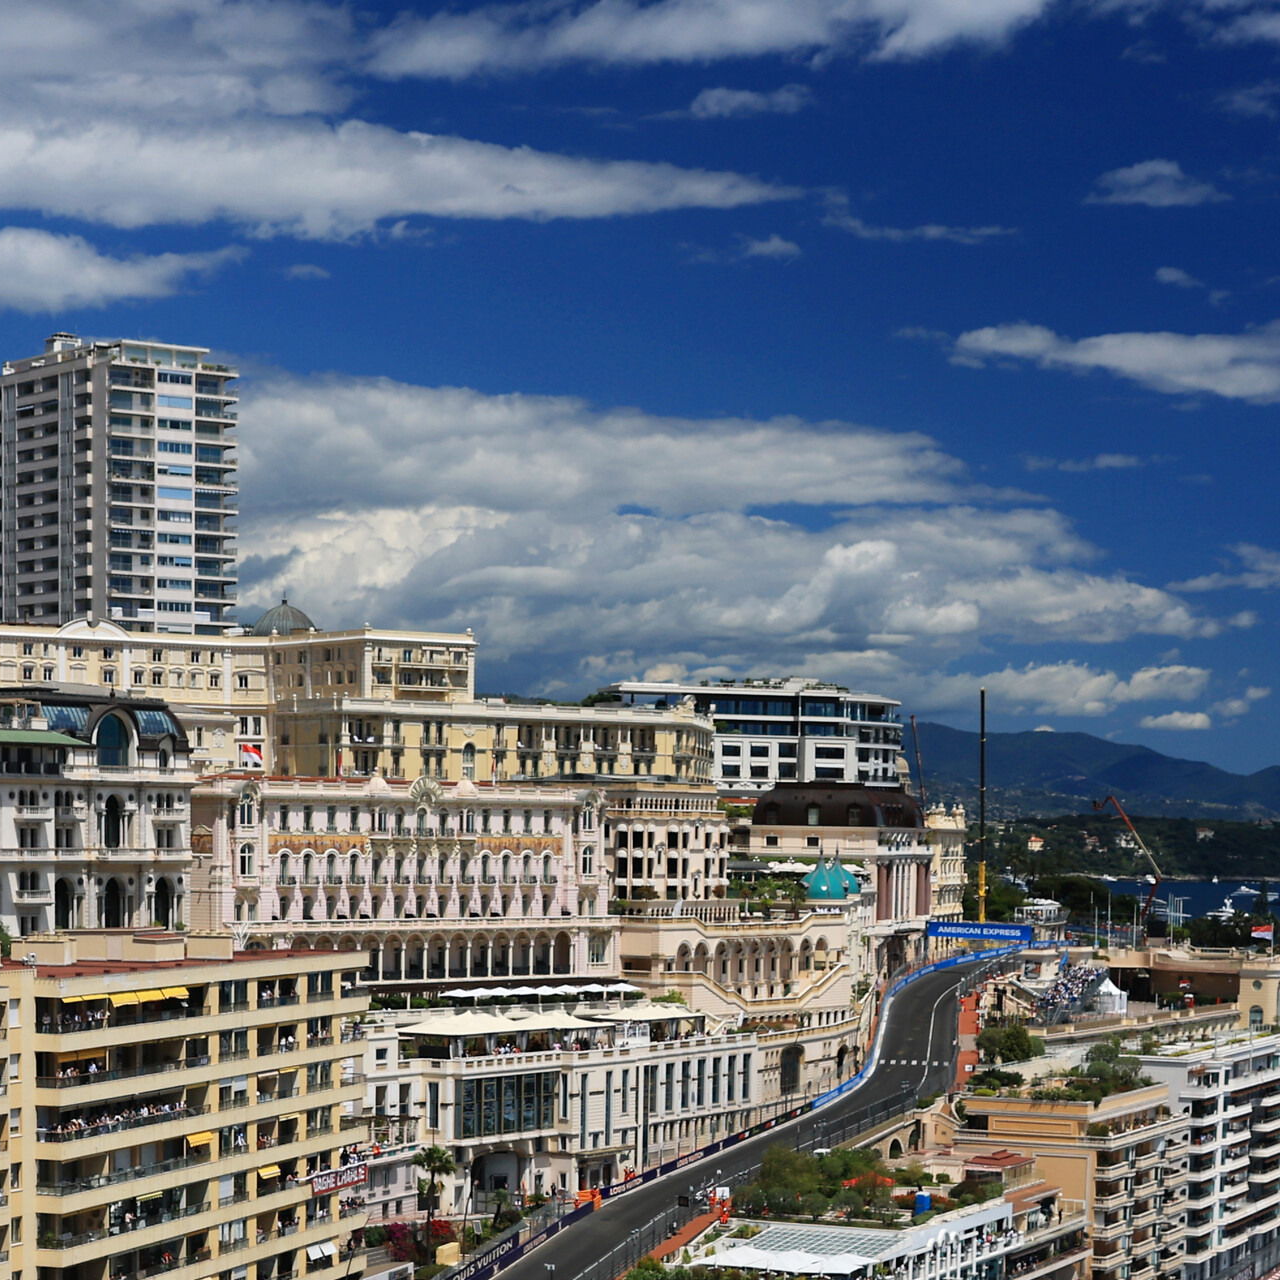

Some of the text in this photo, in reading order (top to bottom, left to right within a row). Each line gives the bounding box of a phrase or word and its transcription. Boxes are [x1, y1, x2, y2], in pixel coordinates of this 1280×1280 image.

[937, 926, 1022, 937] AMERICAN EXPRESS
[476, 1239, 513, 1270] VUITTON
